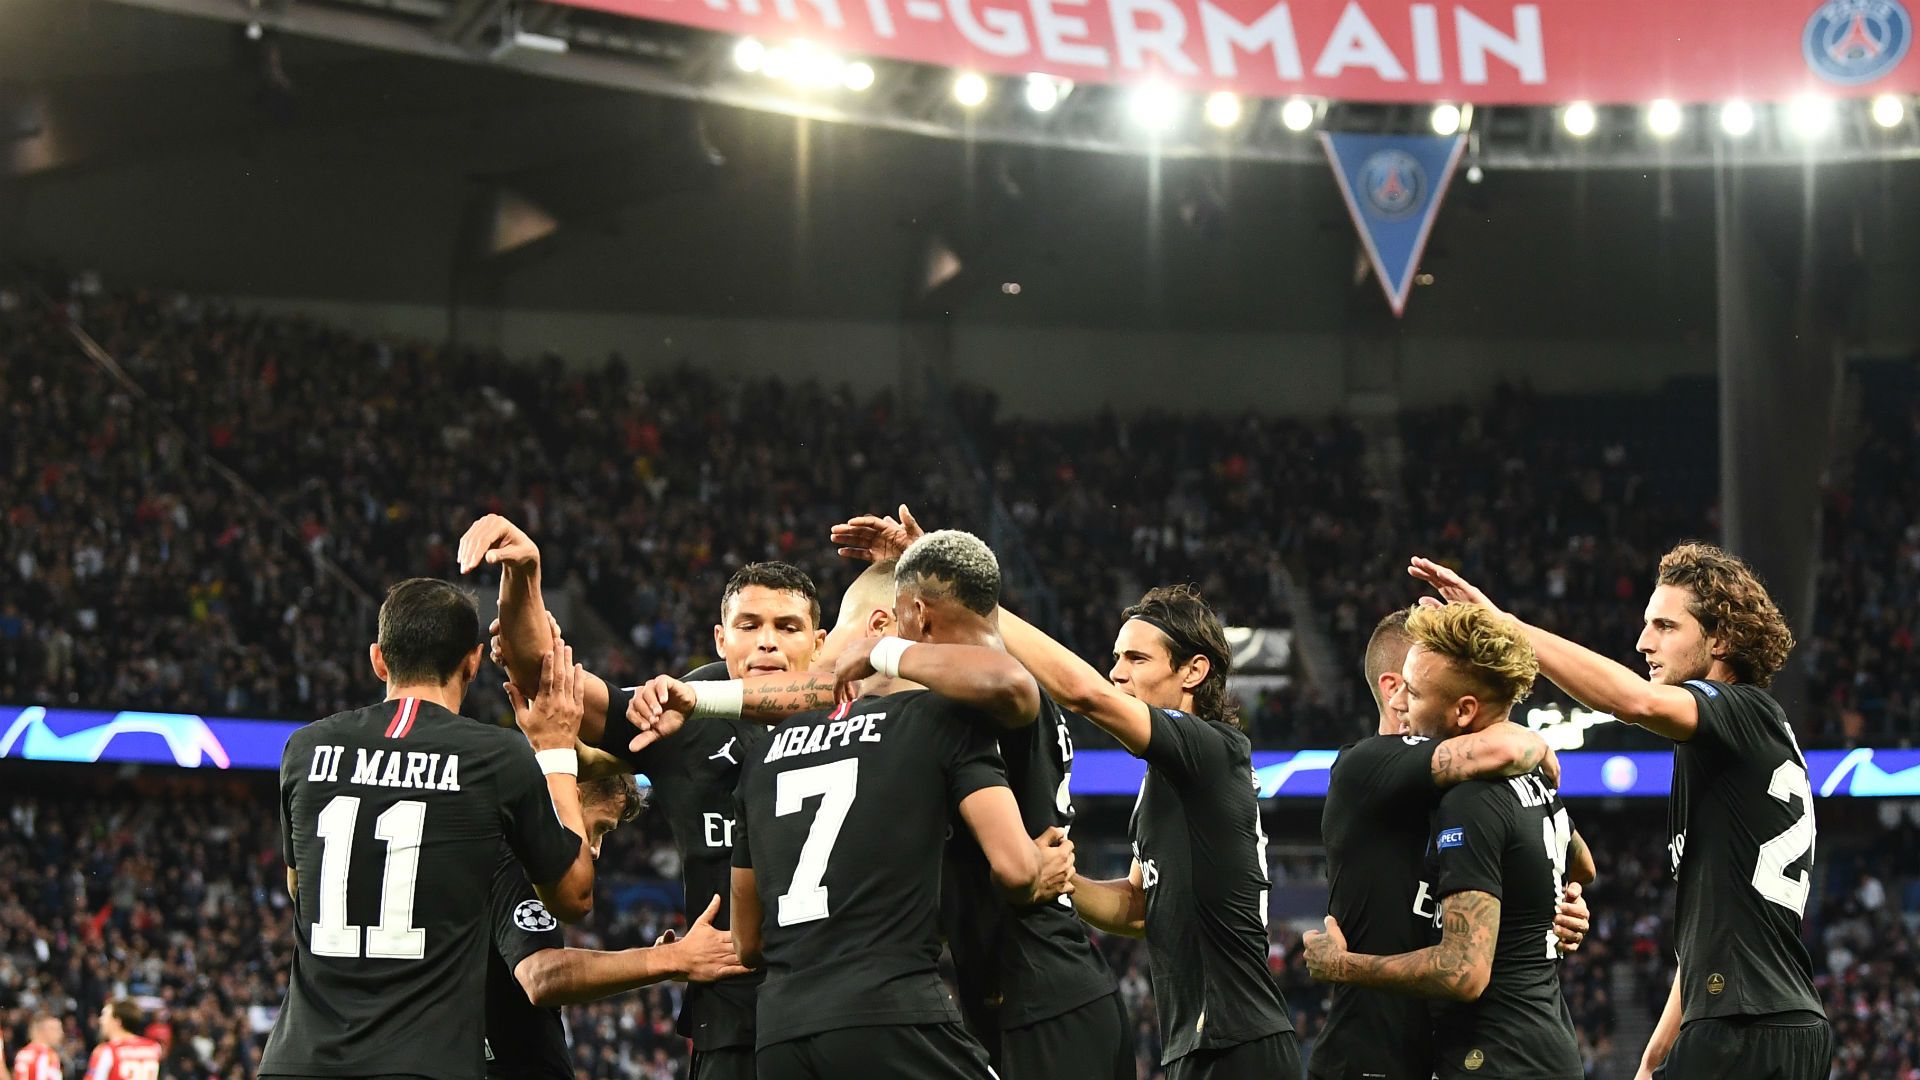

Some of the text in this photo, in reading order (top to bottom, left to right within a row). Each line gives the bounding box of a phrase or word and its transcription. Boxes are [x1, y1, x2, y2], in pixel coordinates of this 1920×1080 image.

[703, 0, 1547, 84] -GERMAIN
[308, 745, 461, 791] DI MARIA
[764, 713, 886, 764] MBAPPE
[310, 795, 427, 959] 11
[775, 757, 859, 927] 7
[1752, 759, 1817, 920] 2
